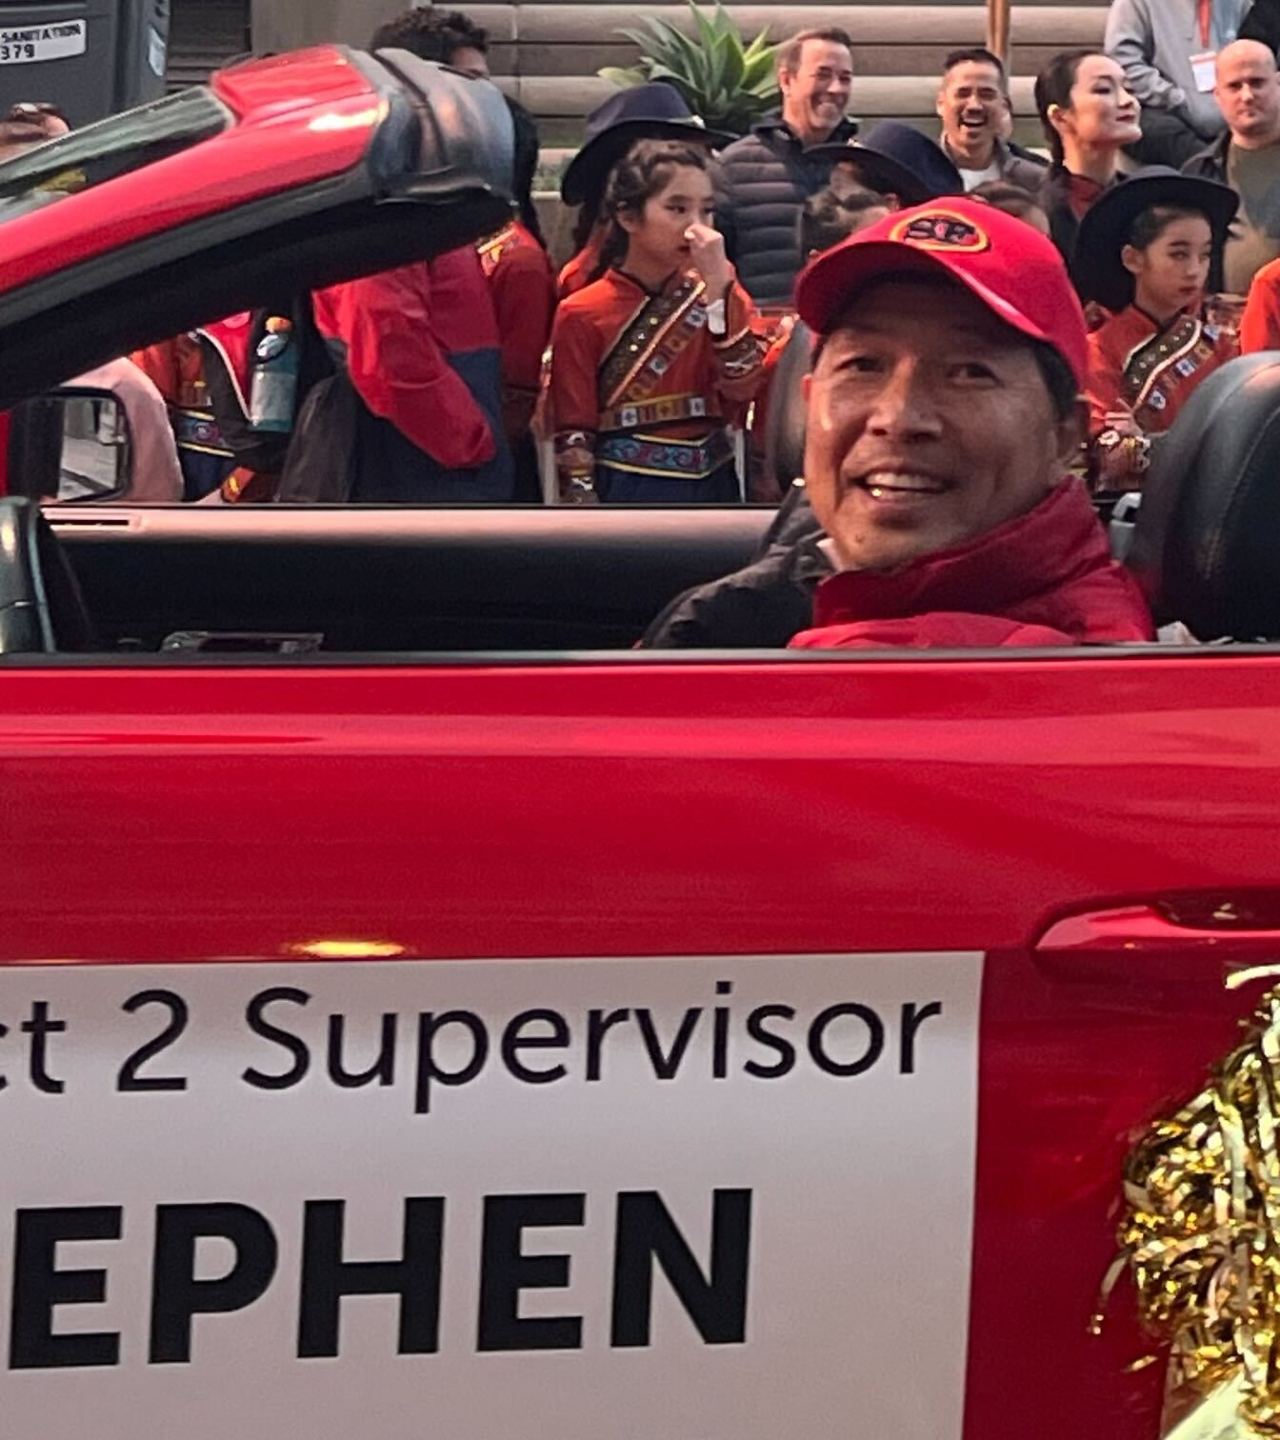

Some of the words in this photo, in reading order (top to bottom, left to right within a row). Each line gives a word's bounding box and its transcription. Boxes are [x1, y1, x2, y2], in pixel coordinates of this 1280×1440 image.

[0, 1001, 67, 1094] t
[116, 988, 188, 1092] 2
[241, 979, 942, 1114] Supervisor
[8, 1187, 753, 1368] EPHEN
